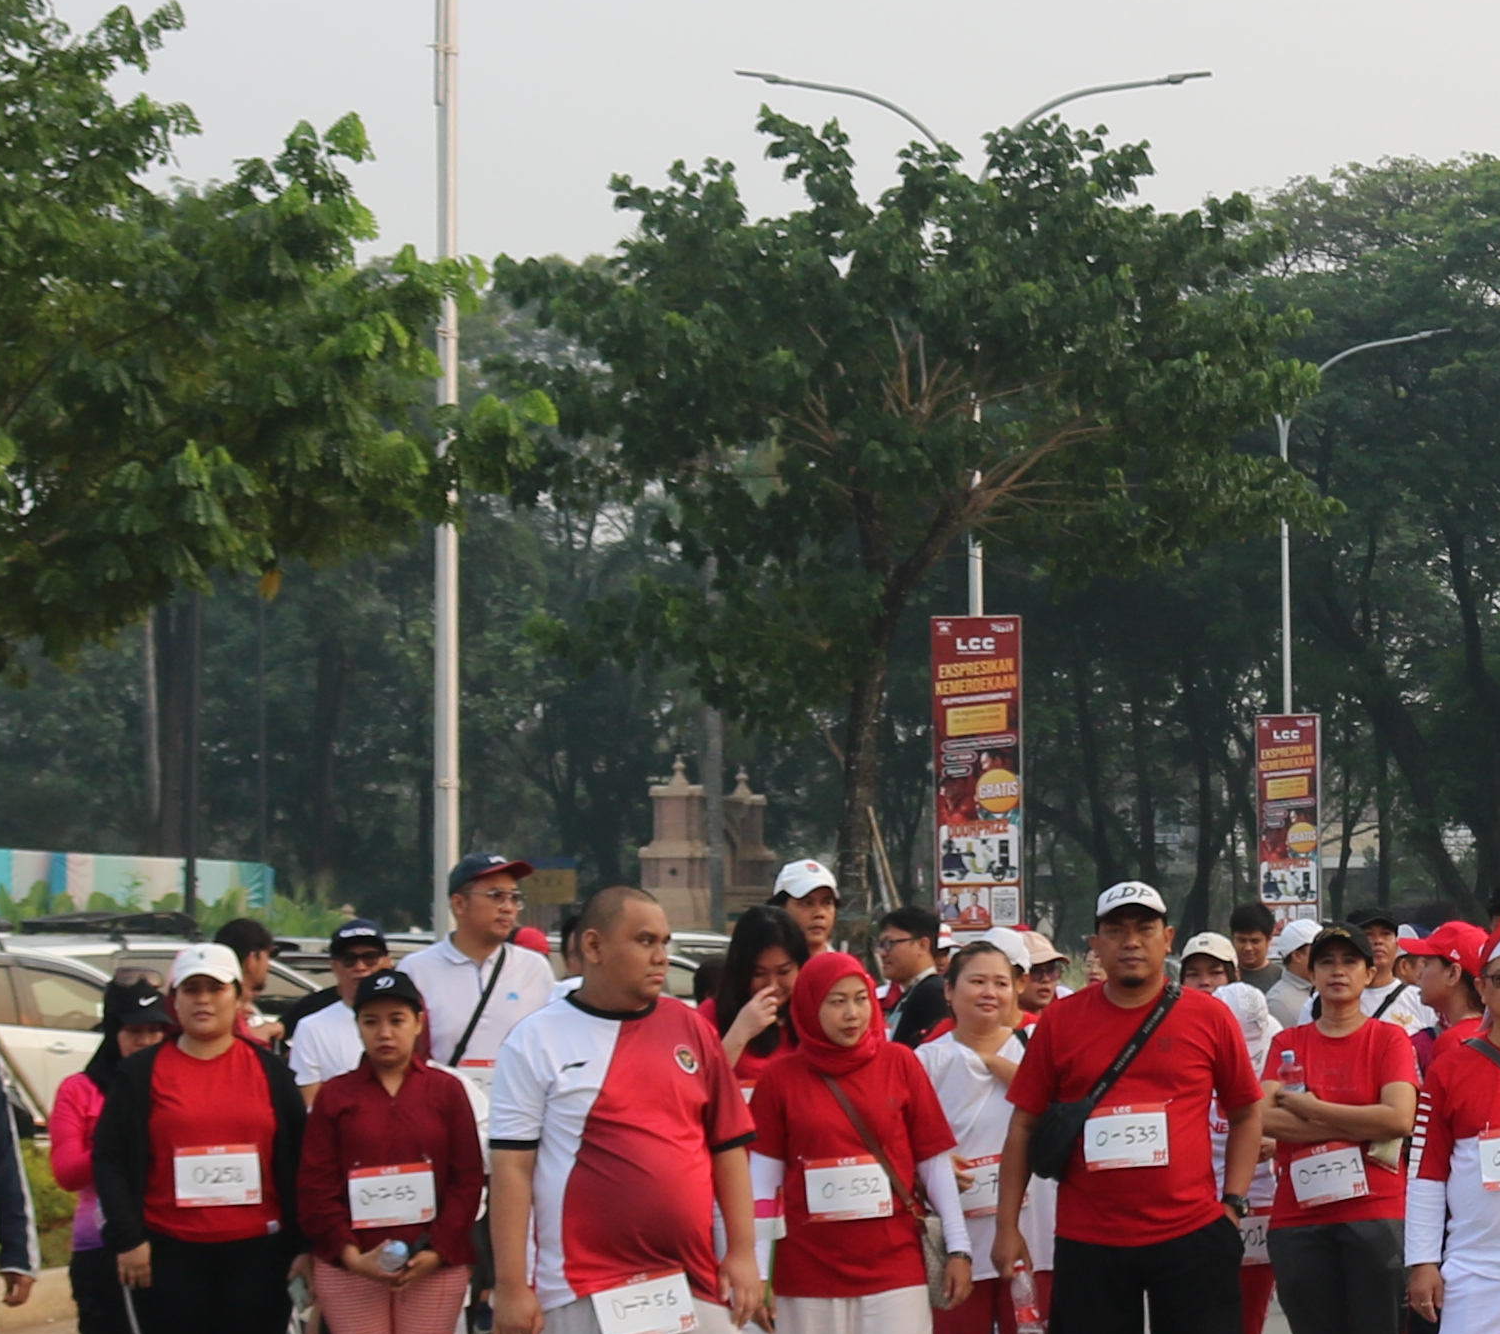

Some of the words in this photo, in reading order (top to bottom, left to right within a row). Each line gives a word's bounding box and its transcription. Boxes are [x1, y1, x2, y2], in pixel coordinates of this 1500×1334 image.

[956, 637, 995, 650] LCC
[979, 781, 1018, 799] GRATIS
[1105, 886, 1154, 904] LDP
[1113, 1105, 1132, 1114] LCC
[1095, 1125, 1159, 1147] 0-533
[836, 1156, 858, 1166] LCC
[1298, 1157, 1365, 1185] 0-771
[821, 1176, 882, 1200] 0-532
[610, 1289, 678, 1321] 0-756
